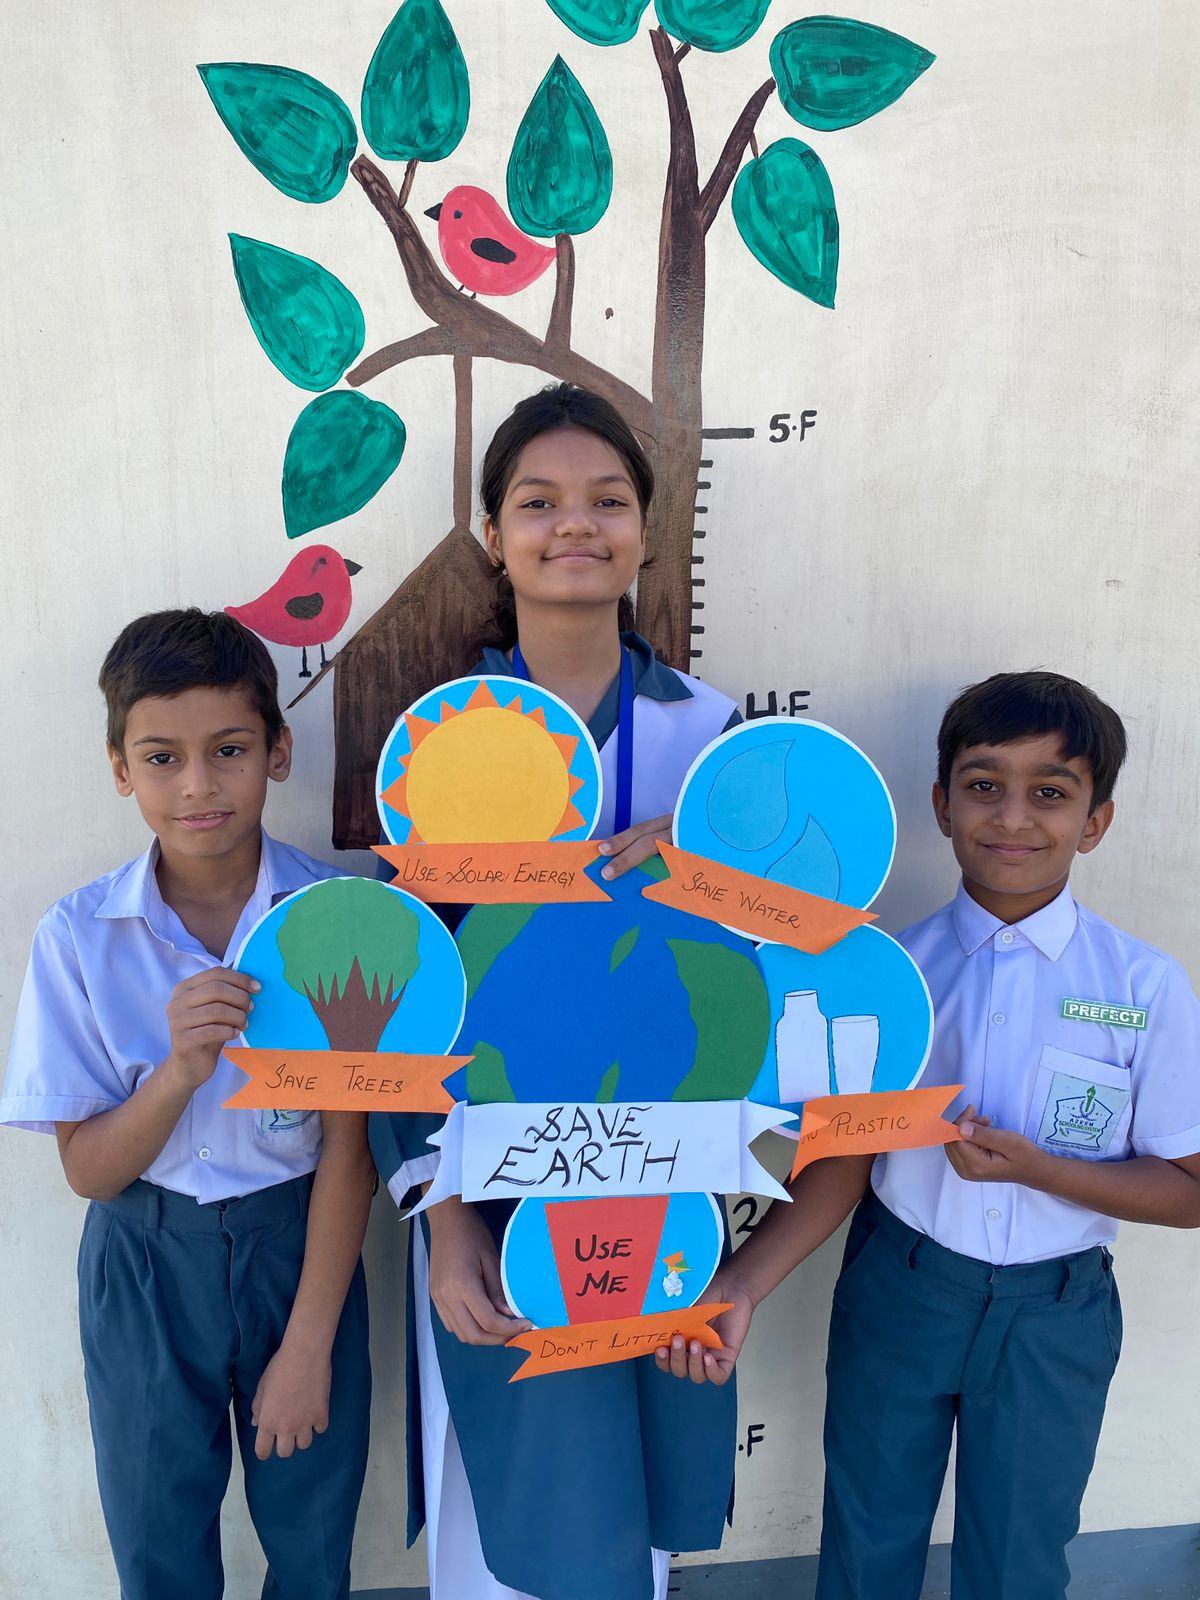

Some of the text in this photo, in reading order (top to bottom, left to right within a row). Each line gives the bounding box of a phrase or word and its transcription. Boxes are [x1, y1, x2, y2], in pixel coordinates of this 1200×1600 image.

[402, 858, 438, 882] USE
[513, 862, 576, 888] ENERGY
[682, 872, 801, 929] SAVE WATER
[1069, 1003, 1141, 1024] PREFECT
[265, 1063, 404, 1094] SAVE TREES
[524, 1105, 653, 1144] SAVE
[829, 1111, 911, 1138] PLASTIC
[483, 1139, 681, 1190] EARTH
[575, 1234, 633, 1262] USE
[576, 1270, 629, 1297] ME
[540, 1339, 598, 1359] DON'T
